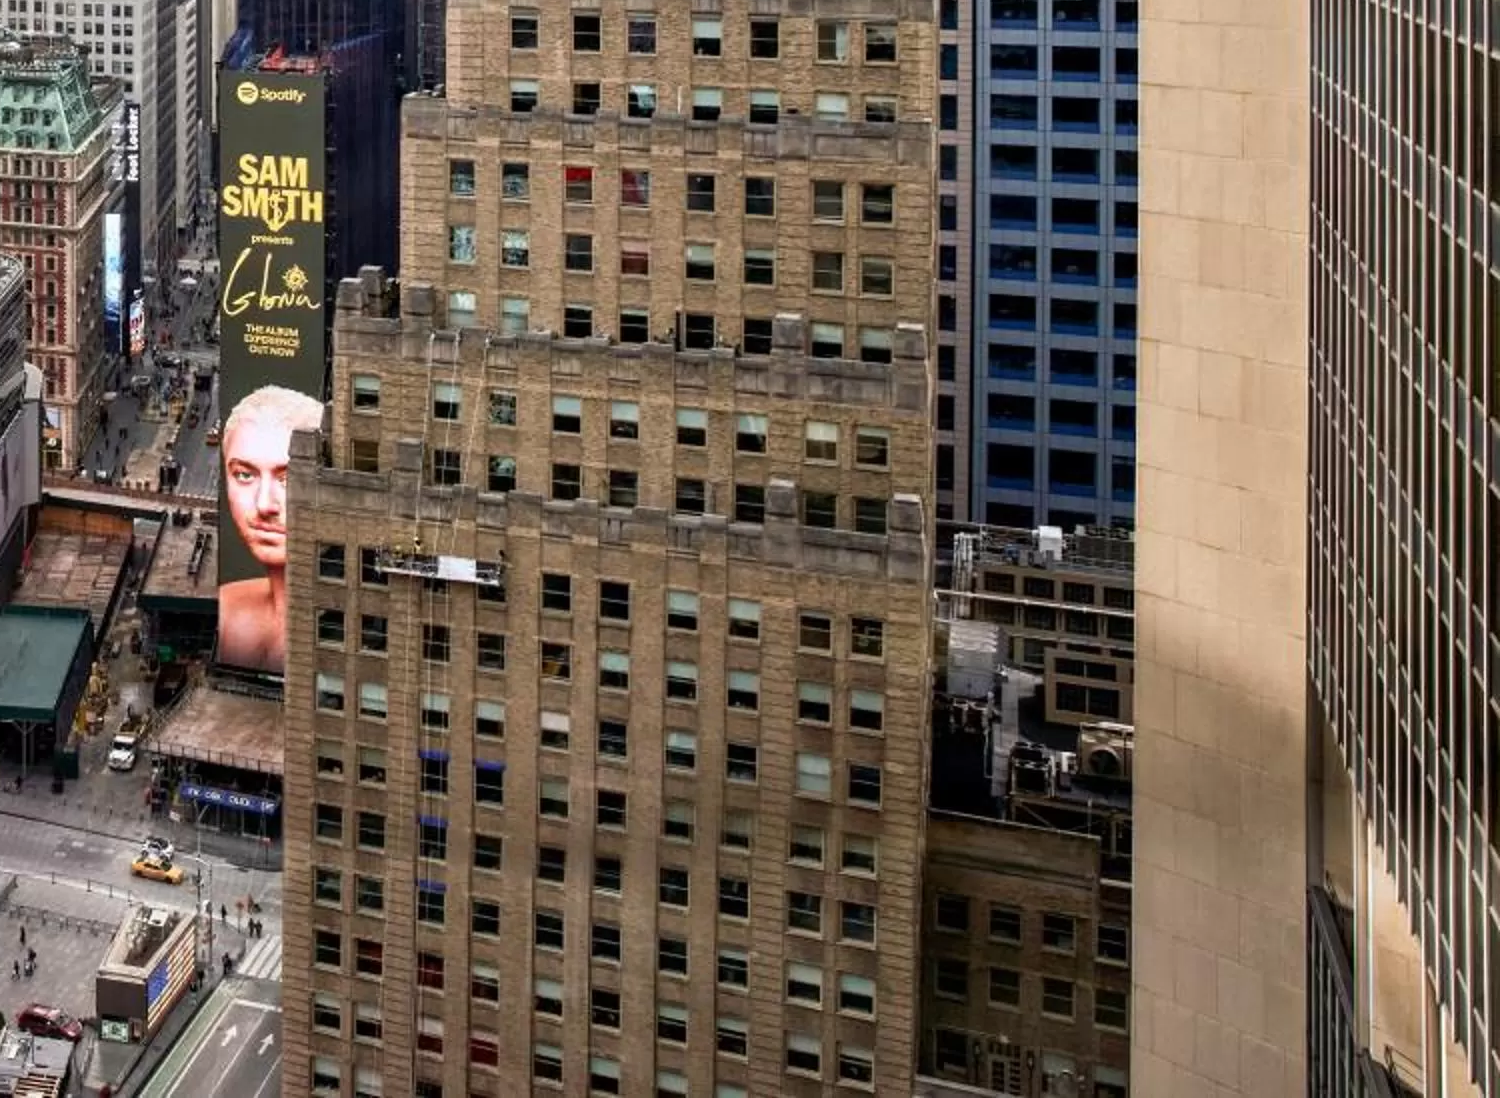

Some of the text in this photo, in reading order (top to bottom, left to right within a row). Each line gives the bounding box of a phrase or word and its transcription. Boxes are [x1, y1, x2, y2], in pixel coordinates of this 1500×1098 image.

[260, 88, 306, 104] Spotify
[239, 154, 308, 189] SAM
[222, 186, 323, 232] SMITH
[251, 234, 294, 246] presents
